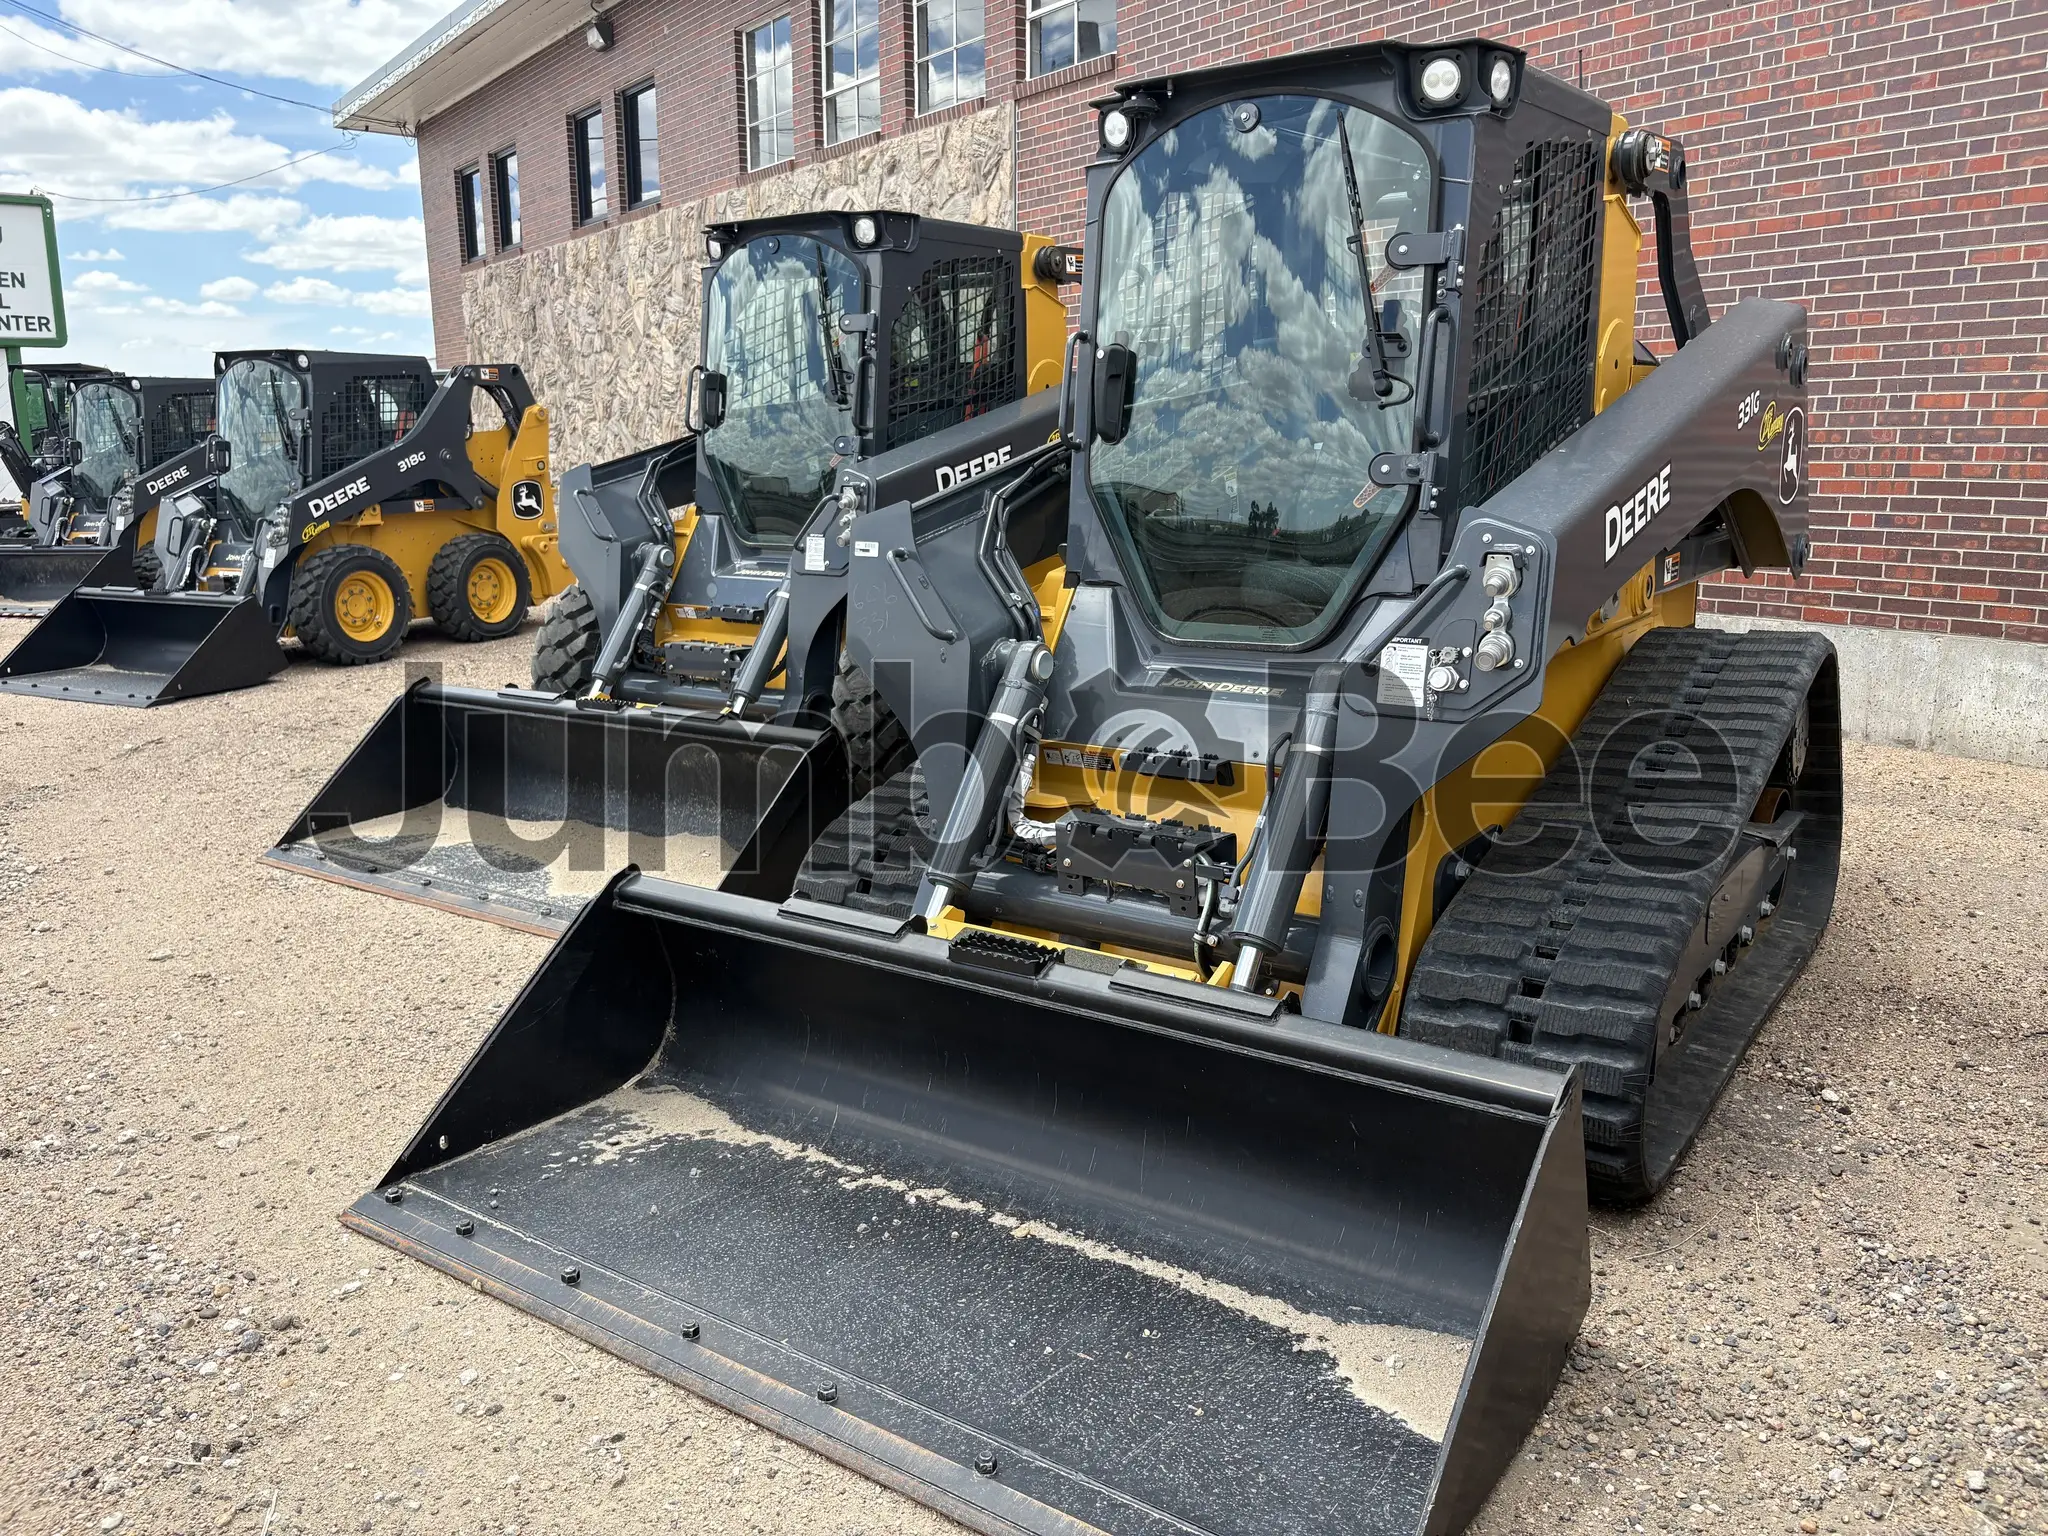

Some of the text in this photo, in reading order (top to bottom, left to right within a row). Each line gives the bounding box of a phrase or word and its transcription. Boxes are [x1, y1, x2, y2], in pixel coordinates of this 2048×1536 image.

[1737, 389, 1761, 430] 331G
[397, 451, 427, 473] 318G
[146, 465, 190, 496] DEERE
[307, 475, 371, 519] DEERE
[1605, 463, 1671, 563] DEERE
[1391, 637, 1423, 645] MPORTANT
